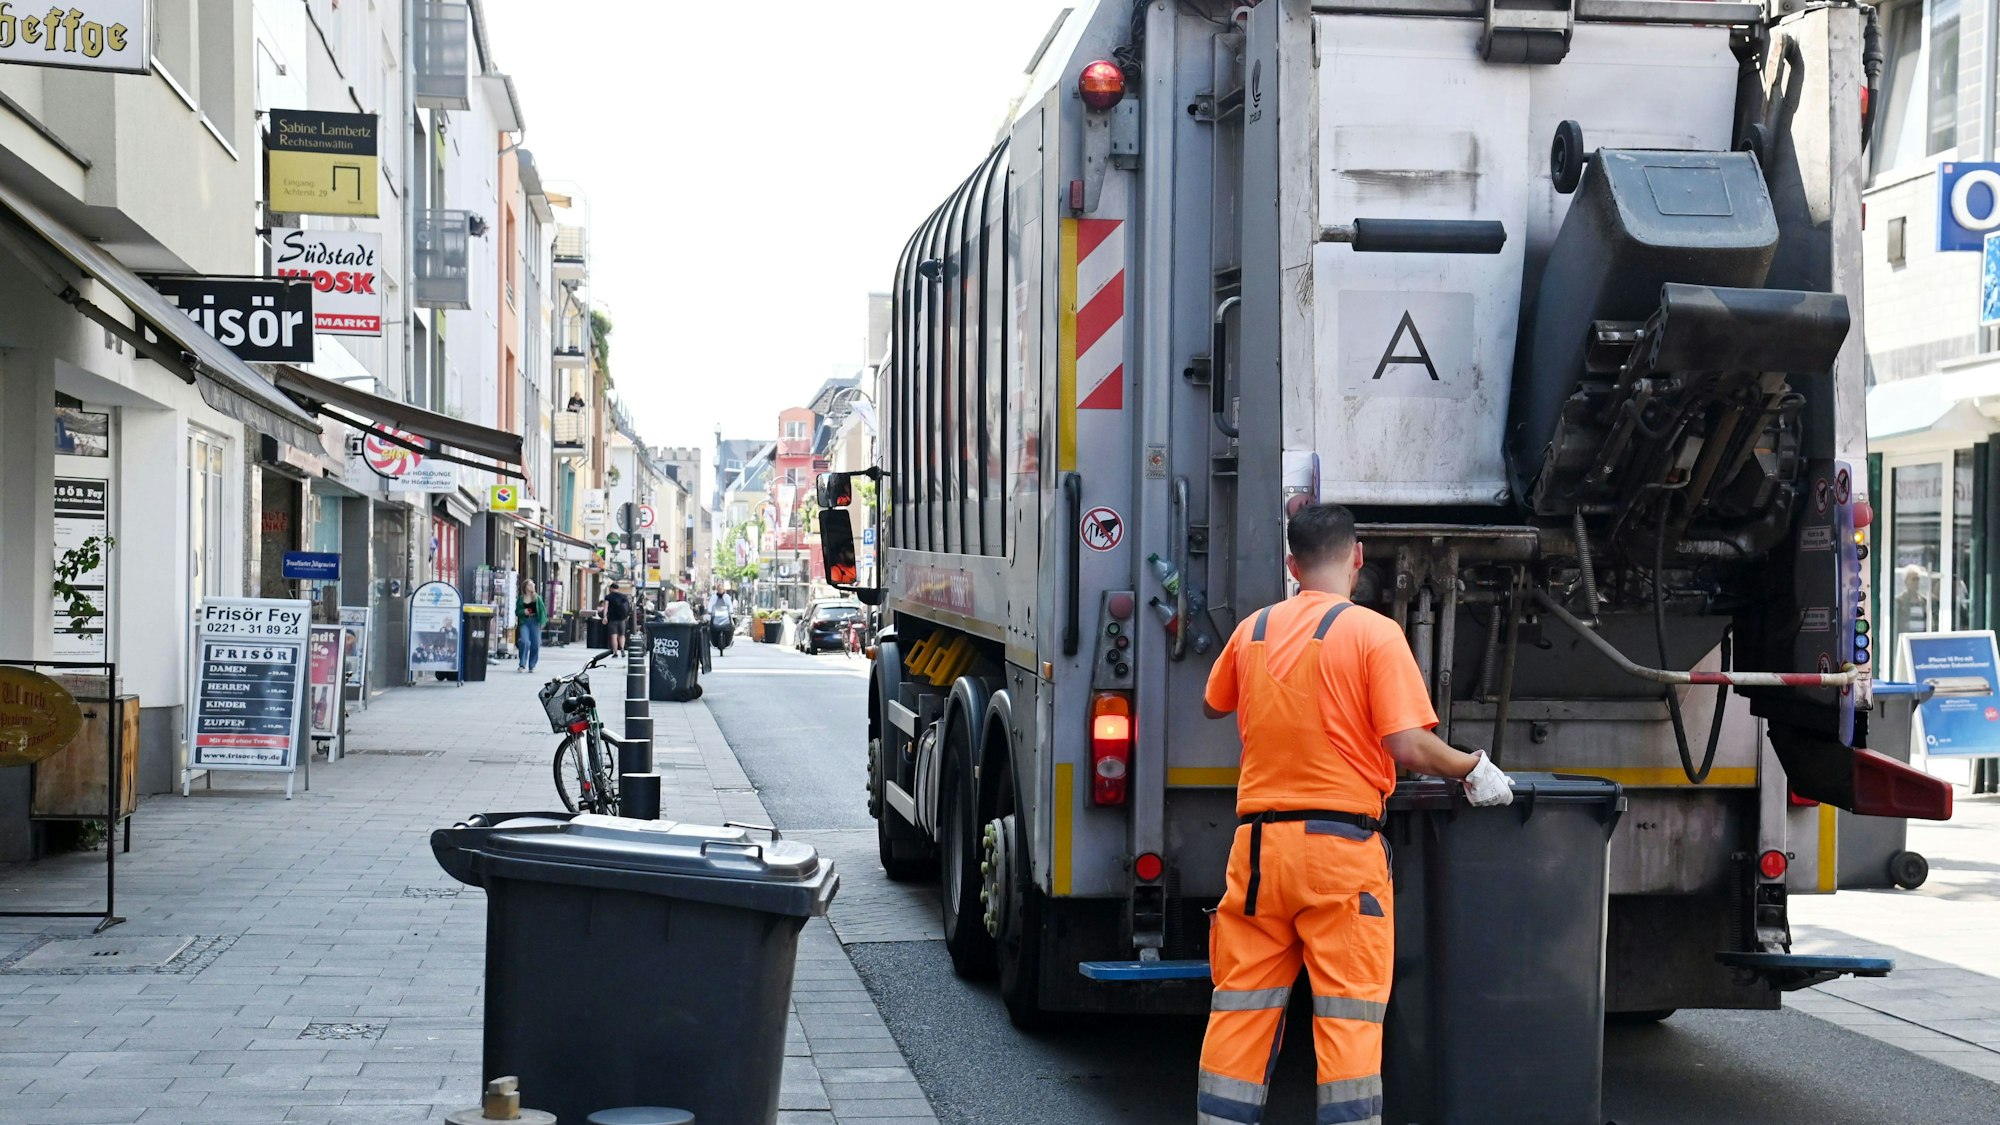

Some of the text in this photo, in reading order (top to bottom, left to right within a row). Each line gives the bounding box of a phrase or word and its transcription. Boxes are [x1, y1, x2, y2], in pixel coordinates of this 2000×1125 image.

[280, 119, 372, 138] Sabine Lambertz
[280, 134, 354, 149] Rechtsanwältin
[277, 230, 375, 267] Südstadt
[1371, 309, 1440, 381] A
[206, 606, 302, 626] Frisör Fey
[207, 623, 235, 633] 0221
[248, 624, 261, 634] 31
[266, 625, 281, 634] 89
[284, 625, 299, 635] 24
[215, 647, 288, 661] FRISÖR
[209, 665, 247, 674] DAMEN
[207, 683, 251, 691] HERREN
[205, 700, 247, 709] KINDER
[204, 719, 245, 728] ZUPFEN
